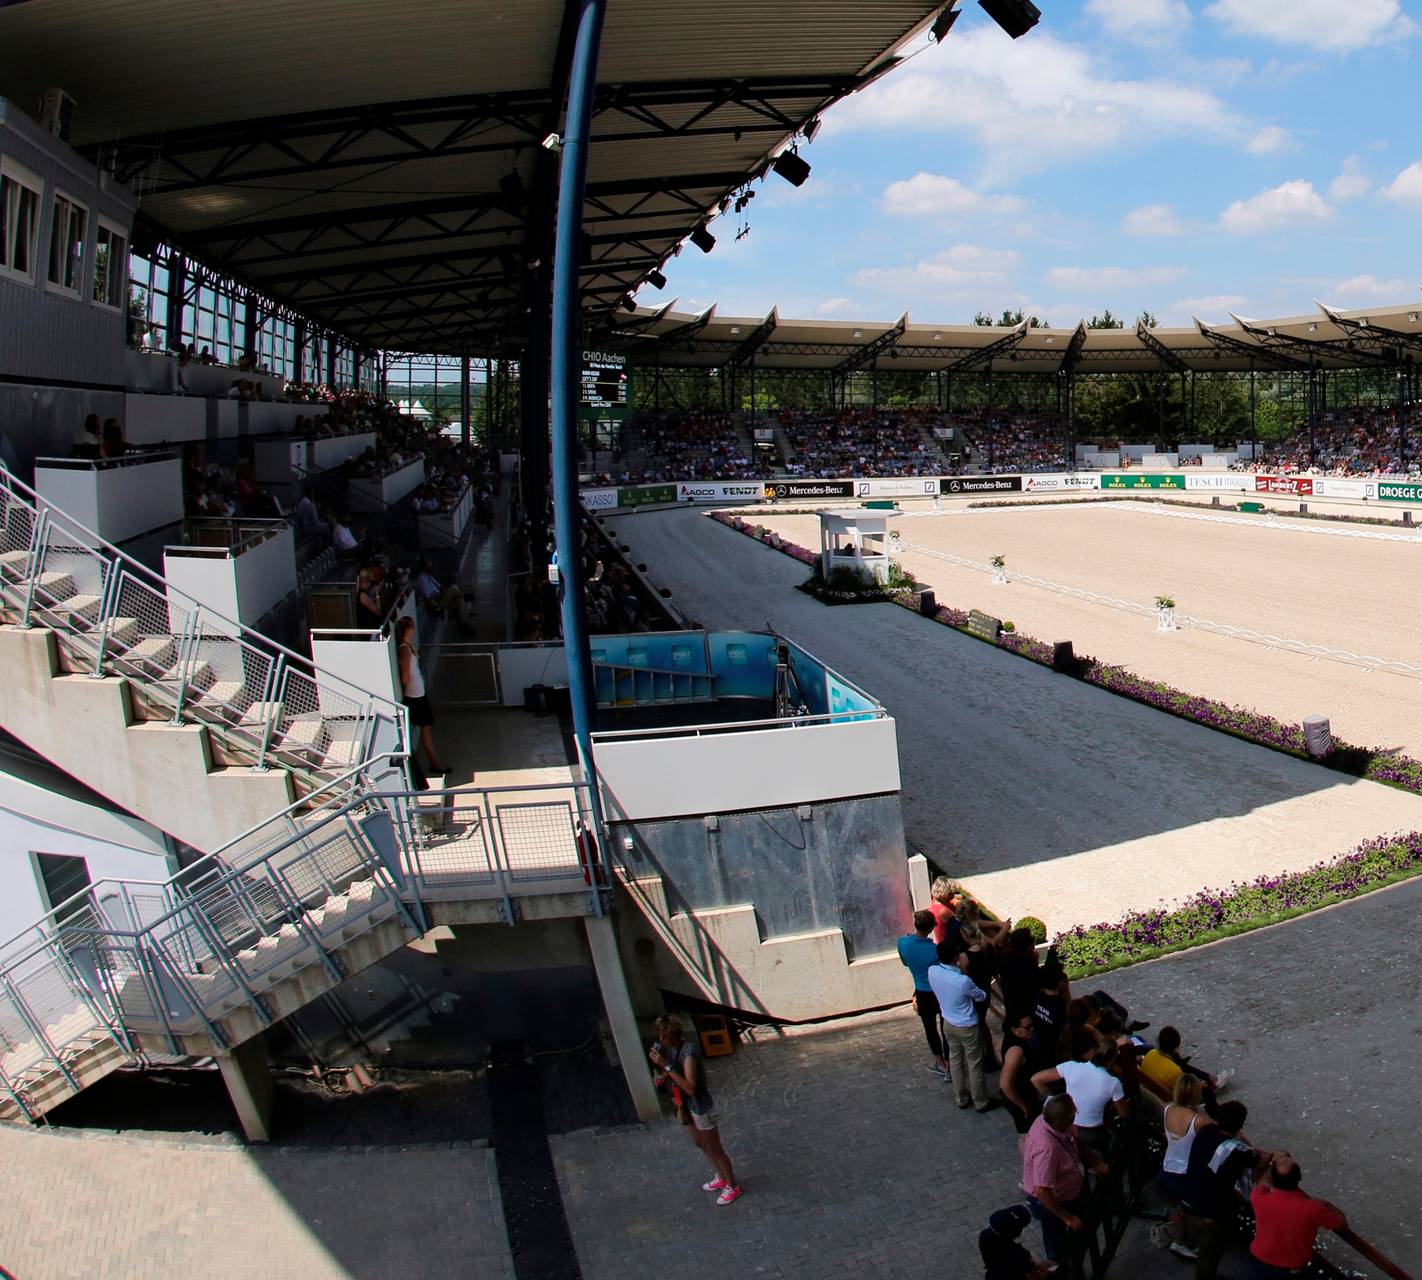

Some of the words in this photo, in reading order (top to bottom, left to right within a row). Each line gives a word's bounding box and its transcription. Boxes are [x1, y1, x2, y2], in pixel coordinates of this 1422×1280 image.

[582, 351, 601, 361] CHIO
[602, 353, 626, 363] Aachen
[962, 481, 1012, 490] Mercedes-Benz
[1063, 478, 1095, 486] FENDT
[1189, 477, 1223, 487] TESCH
[722, 487, 759, 496] FENDT
[789, 485, 843, 495] Mercedes-Benz
[1380, 487, 1415, 498] DROEGE
